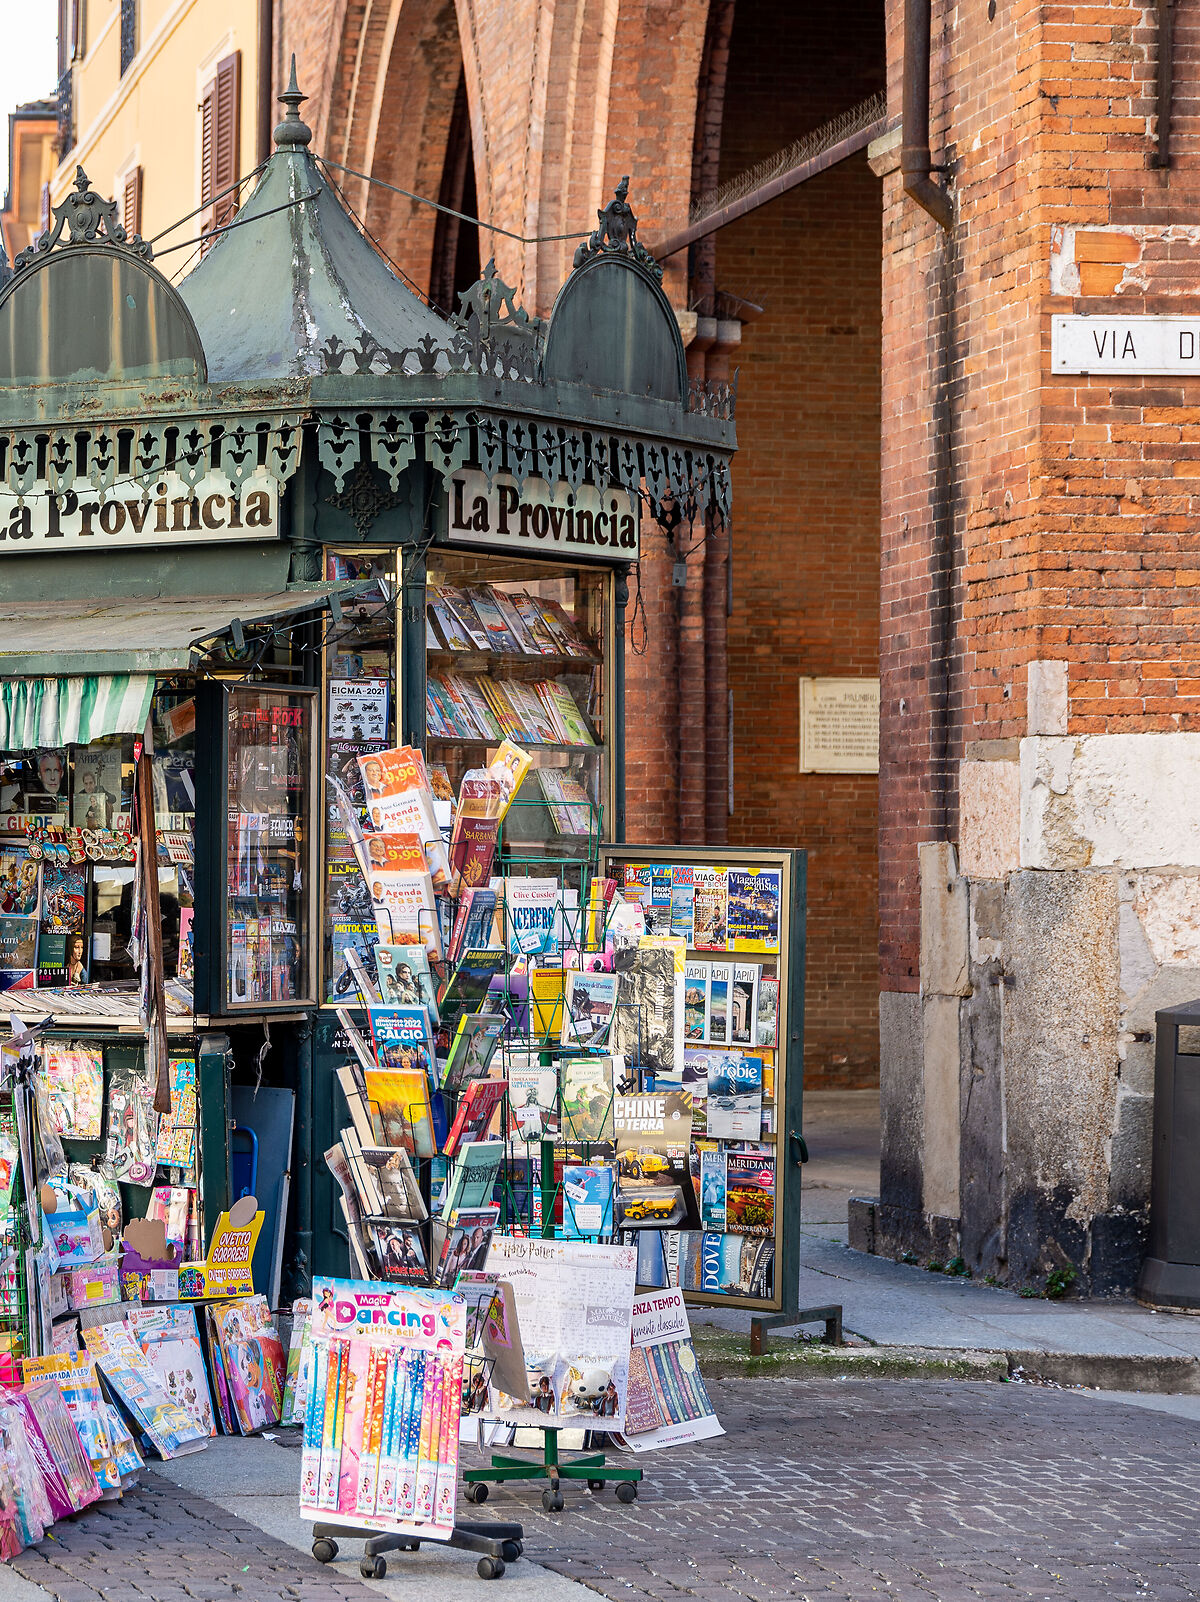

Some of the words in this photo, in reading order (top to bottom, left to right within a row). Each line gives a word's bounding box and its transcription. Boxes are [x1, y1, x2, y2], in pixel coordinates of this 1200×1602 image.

[1093, 330, 1136, 359] VIA
[1180, 332, 1200, 359] D
[44, 481, 273, 538] Provincia
[452, 479, 490, 533] La
[497, 485, 636, 548] Provincia
[331, 687, 362, 695] EICMA
[272, 707, 303, 726] ROCK
[79, 752, 117, 765] Amadeus
[385, 766, 416, 784] 9,90
[384, 806, 419, 820] Agenda
[388, 814, 421, 828] casa
[389, 850, 421, 860] 9,90
[729, 873, 770, 886] Viaggiare
[386, 889, 421, 898] Agenda
[754, 883, 778, 892] gusto
[513, 891, 529, 899] Clive
[532, 891, 556, 899] Cussler
[391, 905, 424, 913] 2022
[513, 907, 555, 930] ICEBERG
[404, 1019, 422, 1027] 2022
[377, 1029, 423, 1039] CALCIO
[713, 1064, 758, 1080] orobie
[626, 1118, 665, 1130] TERRA
[729, 1160, 773, 1170] MERIDIANI
[458, 1218, 494, 1227] PARKER
[219, 1231, 251, 1246] OVETTO
[213, 1246, 250, 1264] SORPRESA
[503, 1242, 528, 1259] Harry
[529, 1241, 555, 1260] Potter
[703, 1233, 722, 1290] DOVE
[208, 1268, 227, 1281] OVETTO
[228, 1268, 251, 1280] SORPRESA
[360, 1295, 387, 1306] Magic
[653, 1295, 681, 1313] TEMPO
[336, 1301, 436, 1337] Dancing
[366, 1326, 393, 1335] Little
[397, 1328, 414, 1337] Bell
